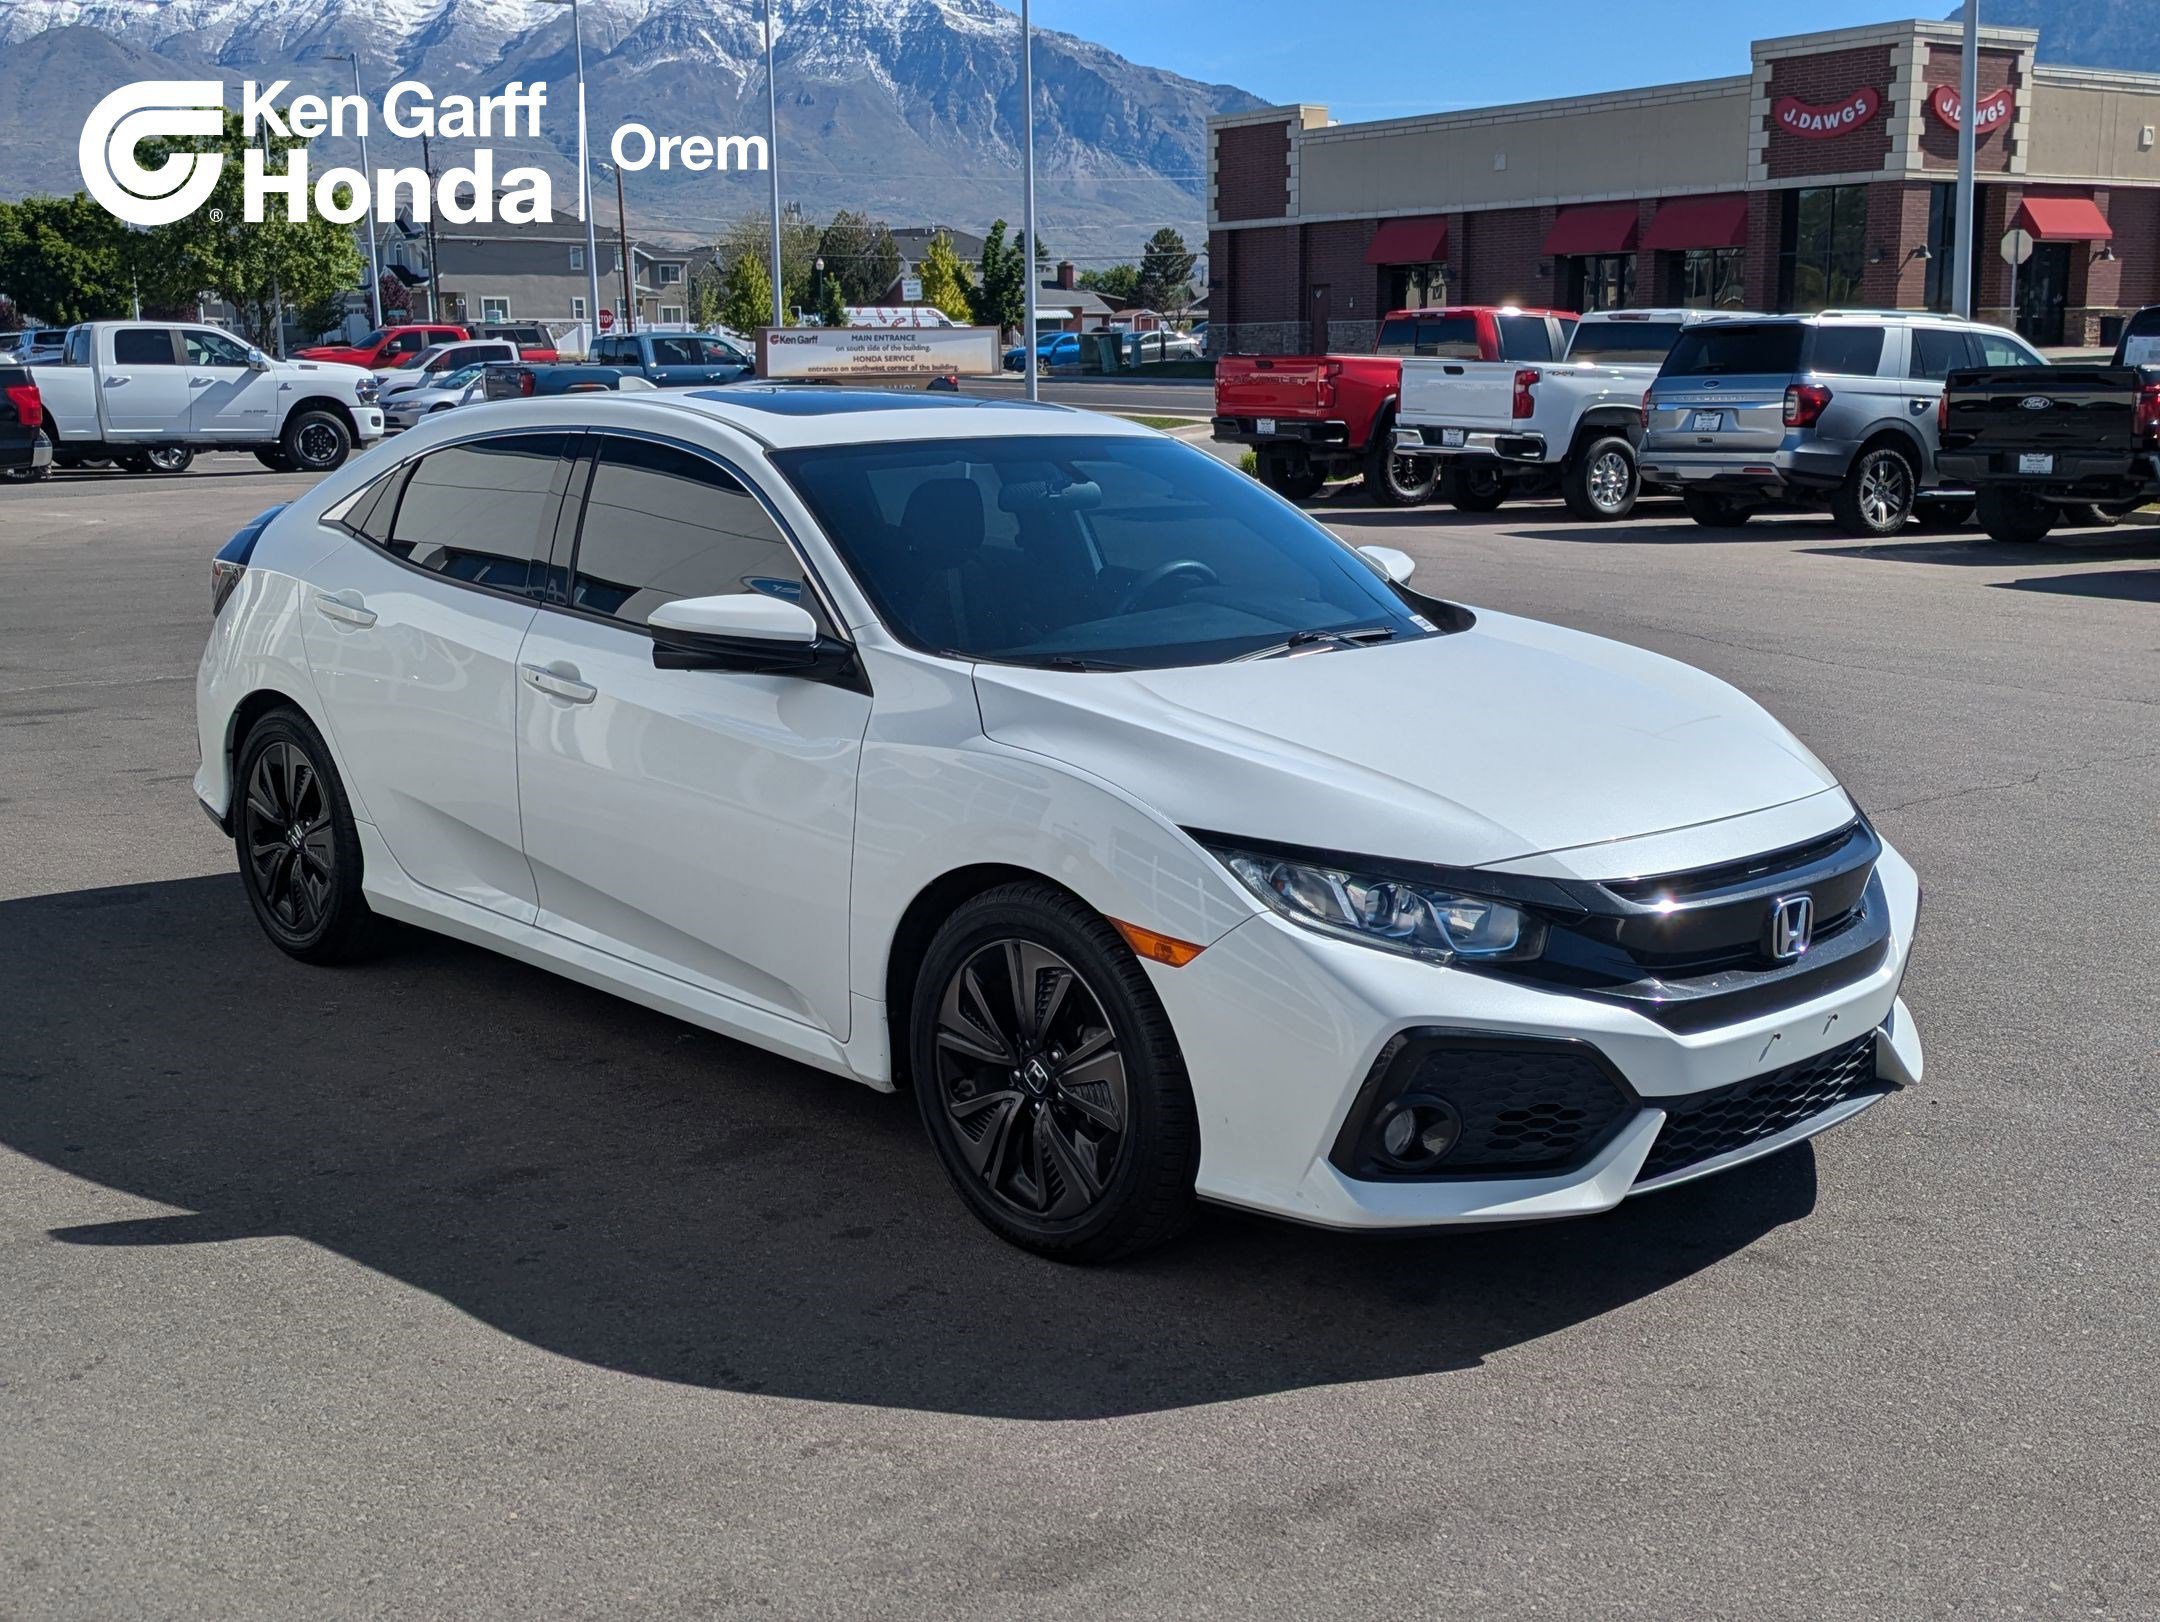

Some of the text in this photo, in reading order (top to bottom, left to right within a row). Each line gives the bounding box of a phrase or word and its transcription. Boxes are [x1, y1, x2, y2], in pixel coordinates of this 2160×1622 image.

[1783, 99, 1867, 130] J.DAWGS
[1942, 98, 2006, 126] J.DWGS
[780, 335, 818, 345] Ken Garff
[851, 334, 916, 342] MAIN ENTRANCE
[846, 344, 865, 352] south
[867, 344, 880, 352] side
[882, 344, 889, 352] of
[890, 344, 902, 352] the
[850, 364, 885, 372] southwest
